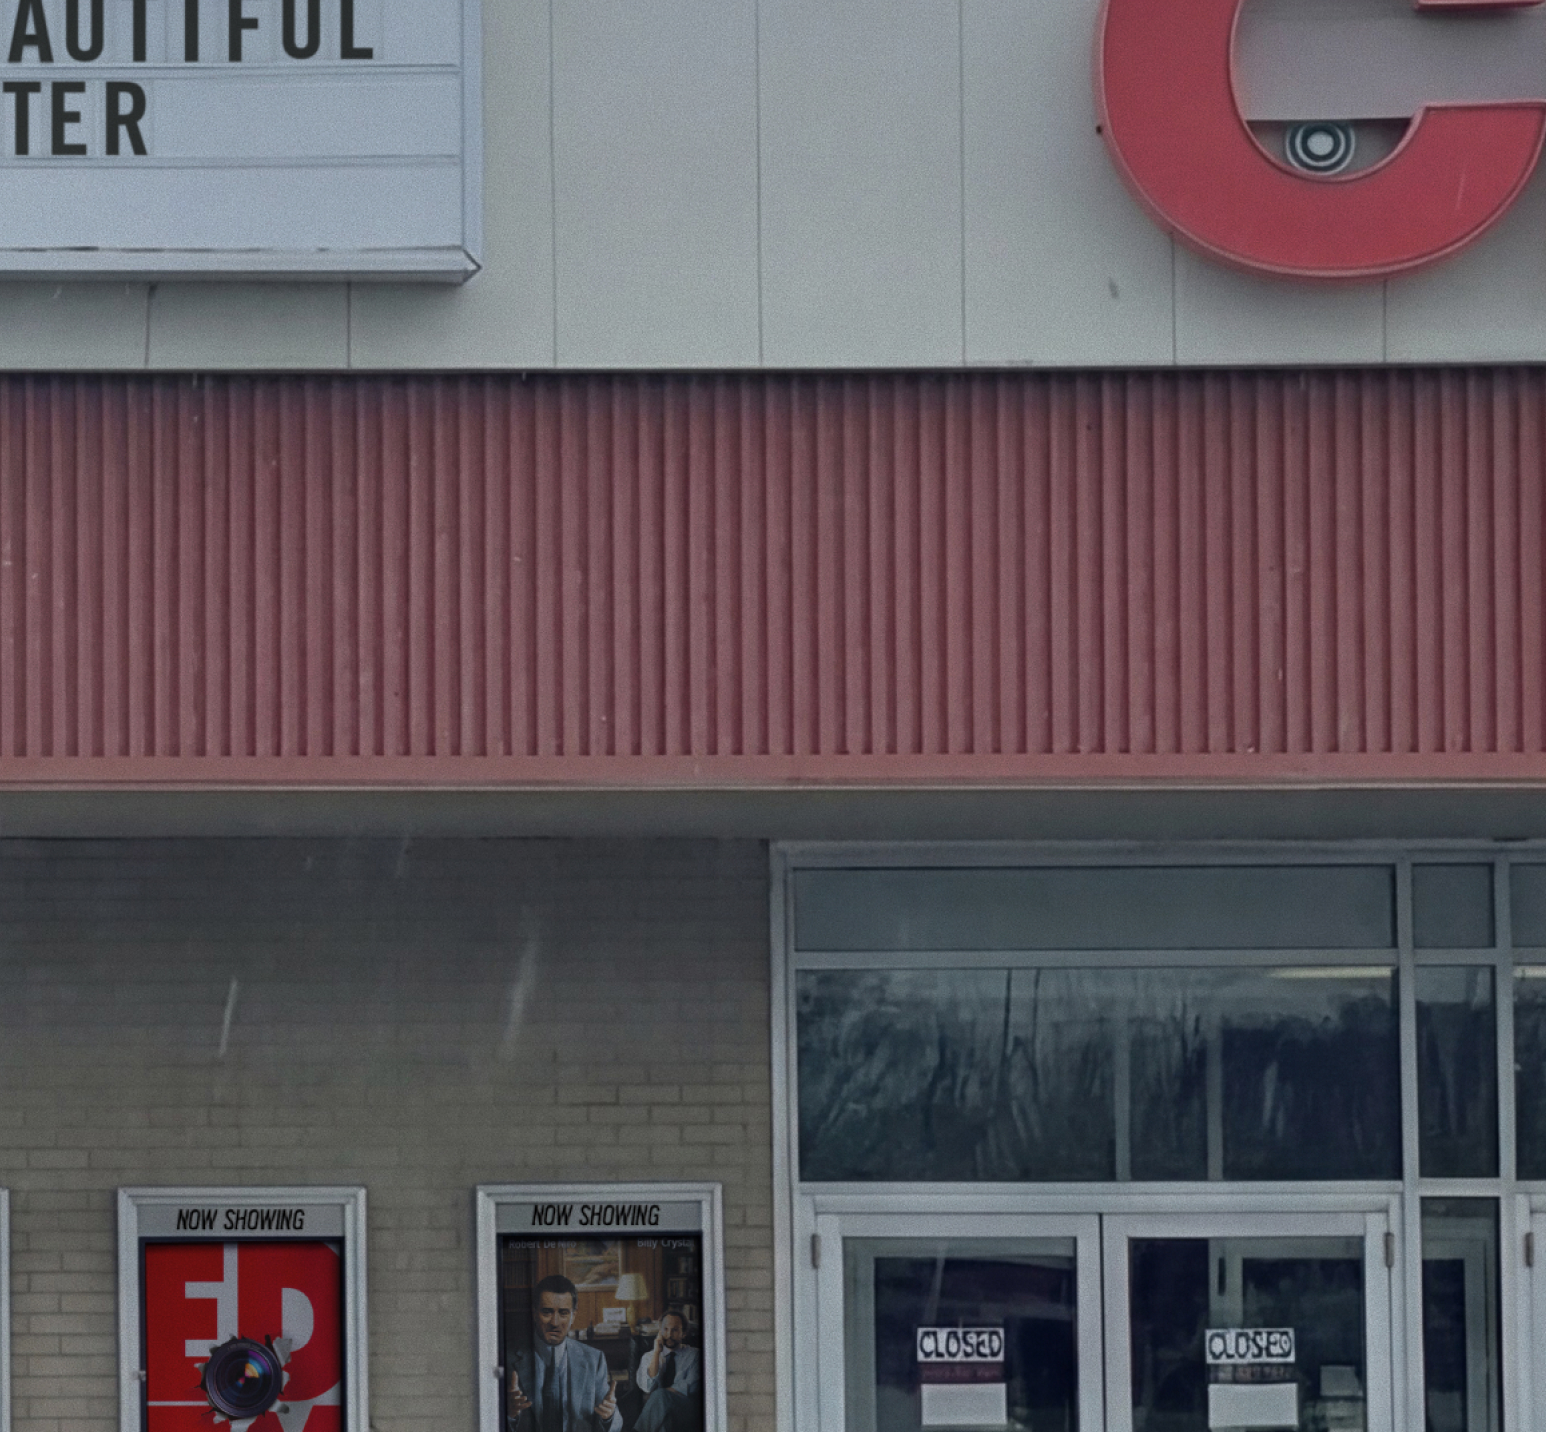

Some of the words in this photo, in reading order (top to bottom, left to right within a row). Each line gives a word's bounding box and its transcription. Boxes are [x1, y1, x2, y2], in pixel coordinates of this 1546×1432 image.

[176, 1209, 218, 1231] NOW
[223, 1209, 305, 1231] SHOWING
[531, 1205, 573, 1227] NOW
[578, 1205, 660, 1227] SHOWING
[508, 1240, 540, 1249] Robert
[543, 1240, 556, 1249] De
[557, 1240, 577, 1249] Niro
[637, 1238, 658, 1249] Billy
[919, 1330, 1002, 1358] CLOSED
[1209, 1330, 1292, 1359] CLOSED
